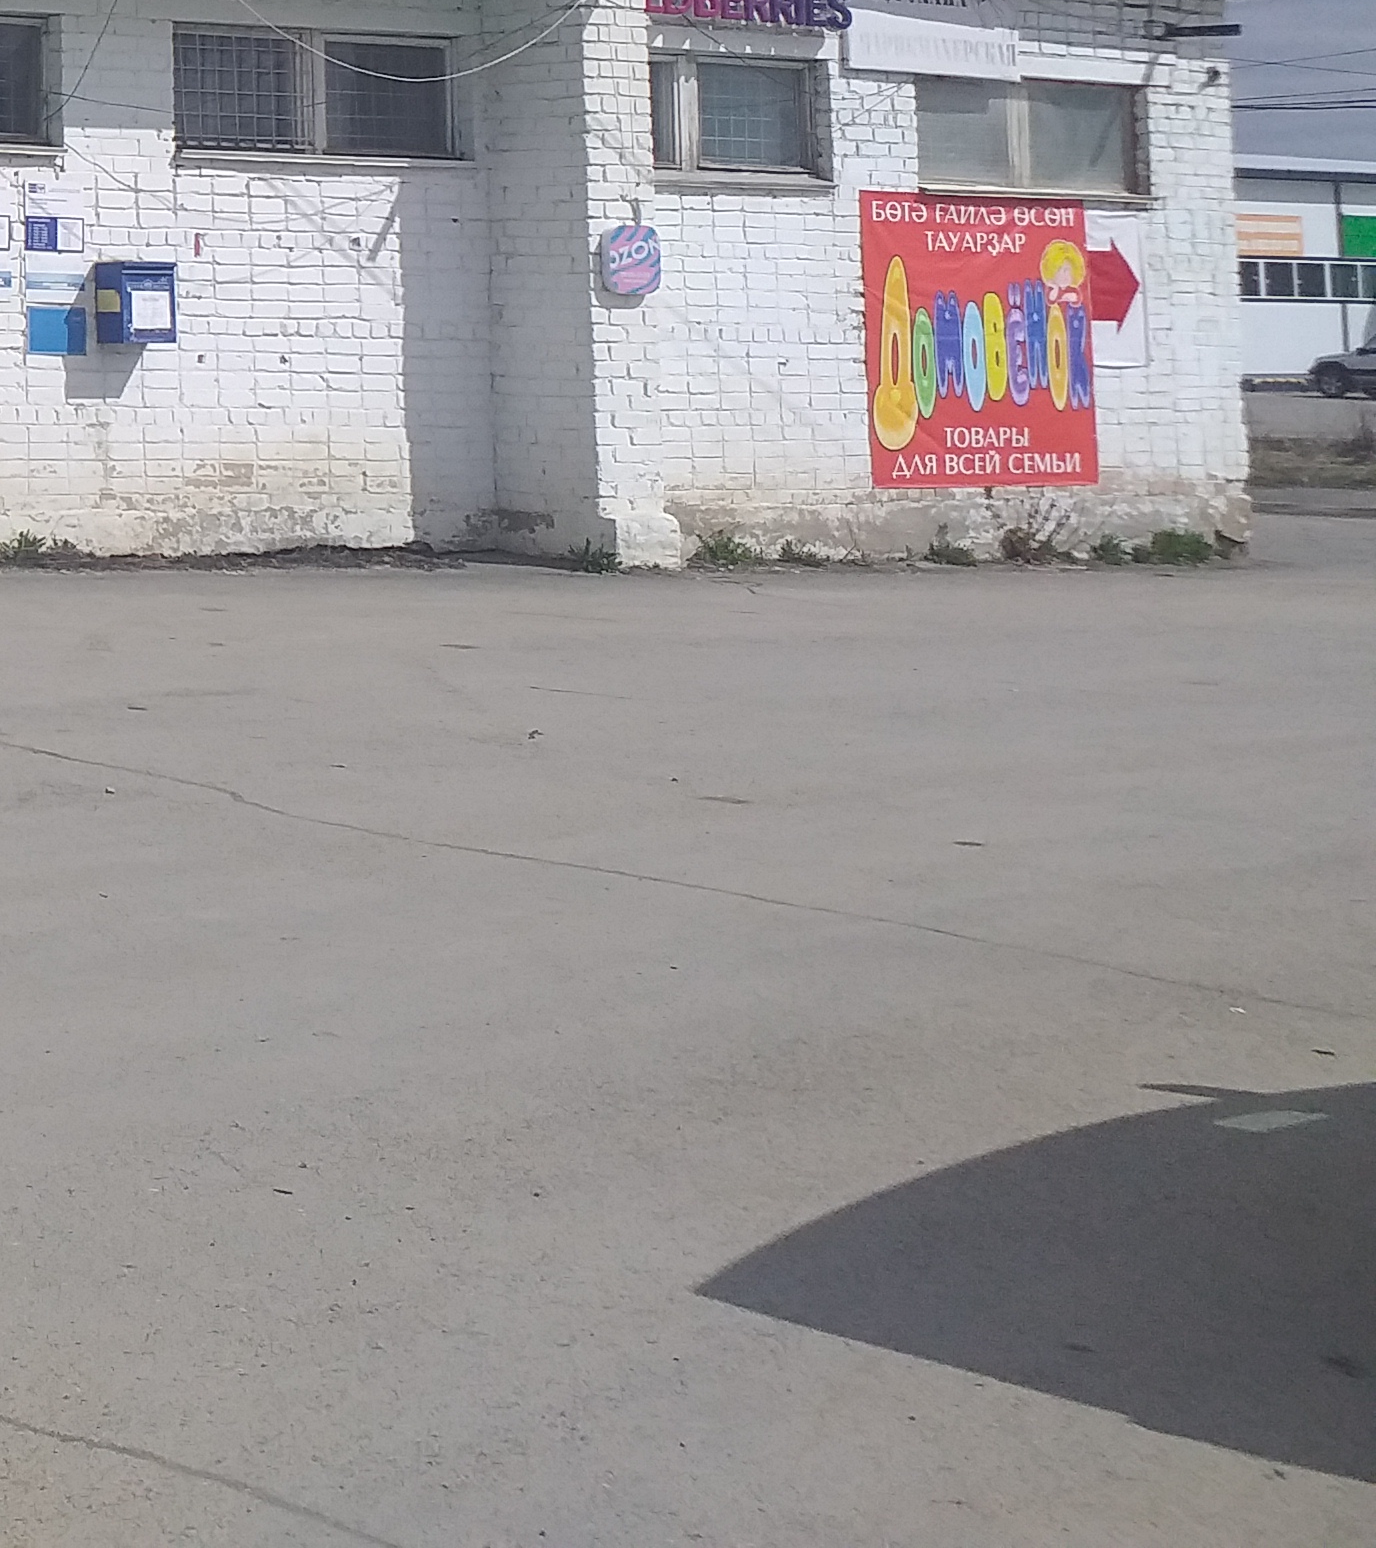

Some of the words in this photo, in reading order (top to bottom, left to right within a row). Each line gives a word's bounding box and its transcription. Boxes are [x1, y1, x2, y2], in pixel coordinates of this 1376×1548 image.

[944, 426, 1030, 448] ТОВАРЫ
[891, 454, 938, 479] ДЛЯ
[944, 450, 1000, 475] ВСЕЙ
[1007, 453, 1082, 474] СЕМЬИ
